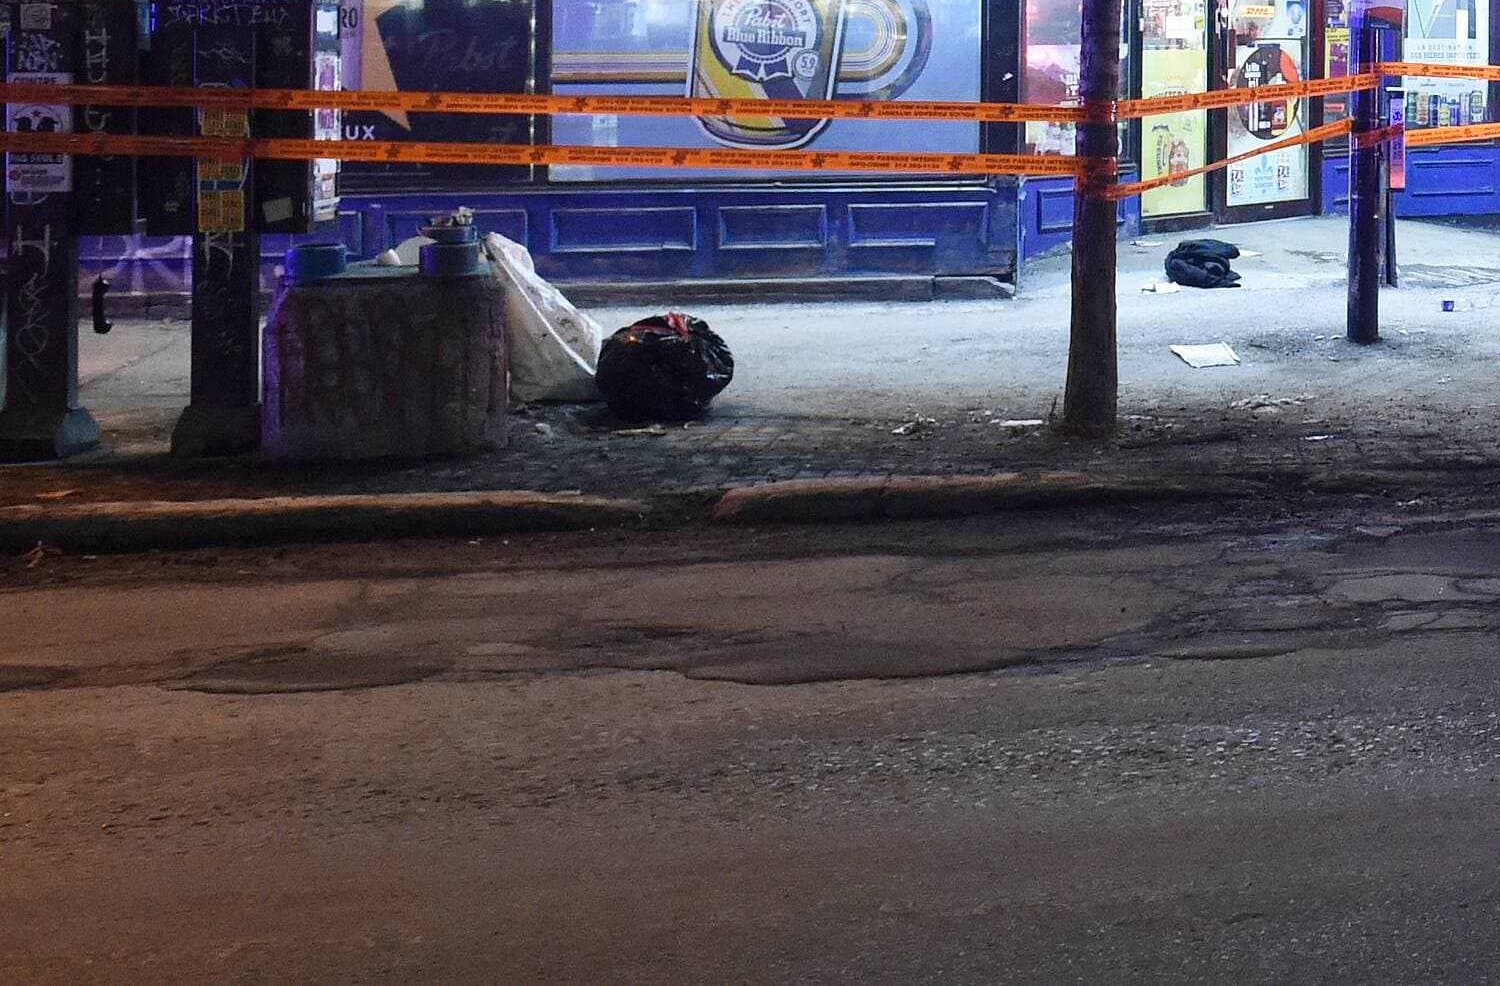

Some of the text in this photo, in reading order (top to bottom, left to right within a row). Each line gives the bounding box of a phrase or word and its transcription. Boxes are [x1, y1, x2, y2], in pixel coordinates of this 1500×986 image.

[744, 4, 788, 28] Pabst
[1246, 7, 1270, 15] DHL
[727, 26, 804, 47] Blue Ribbon
